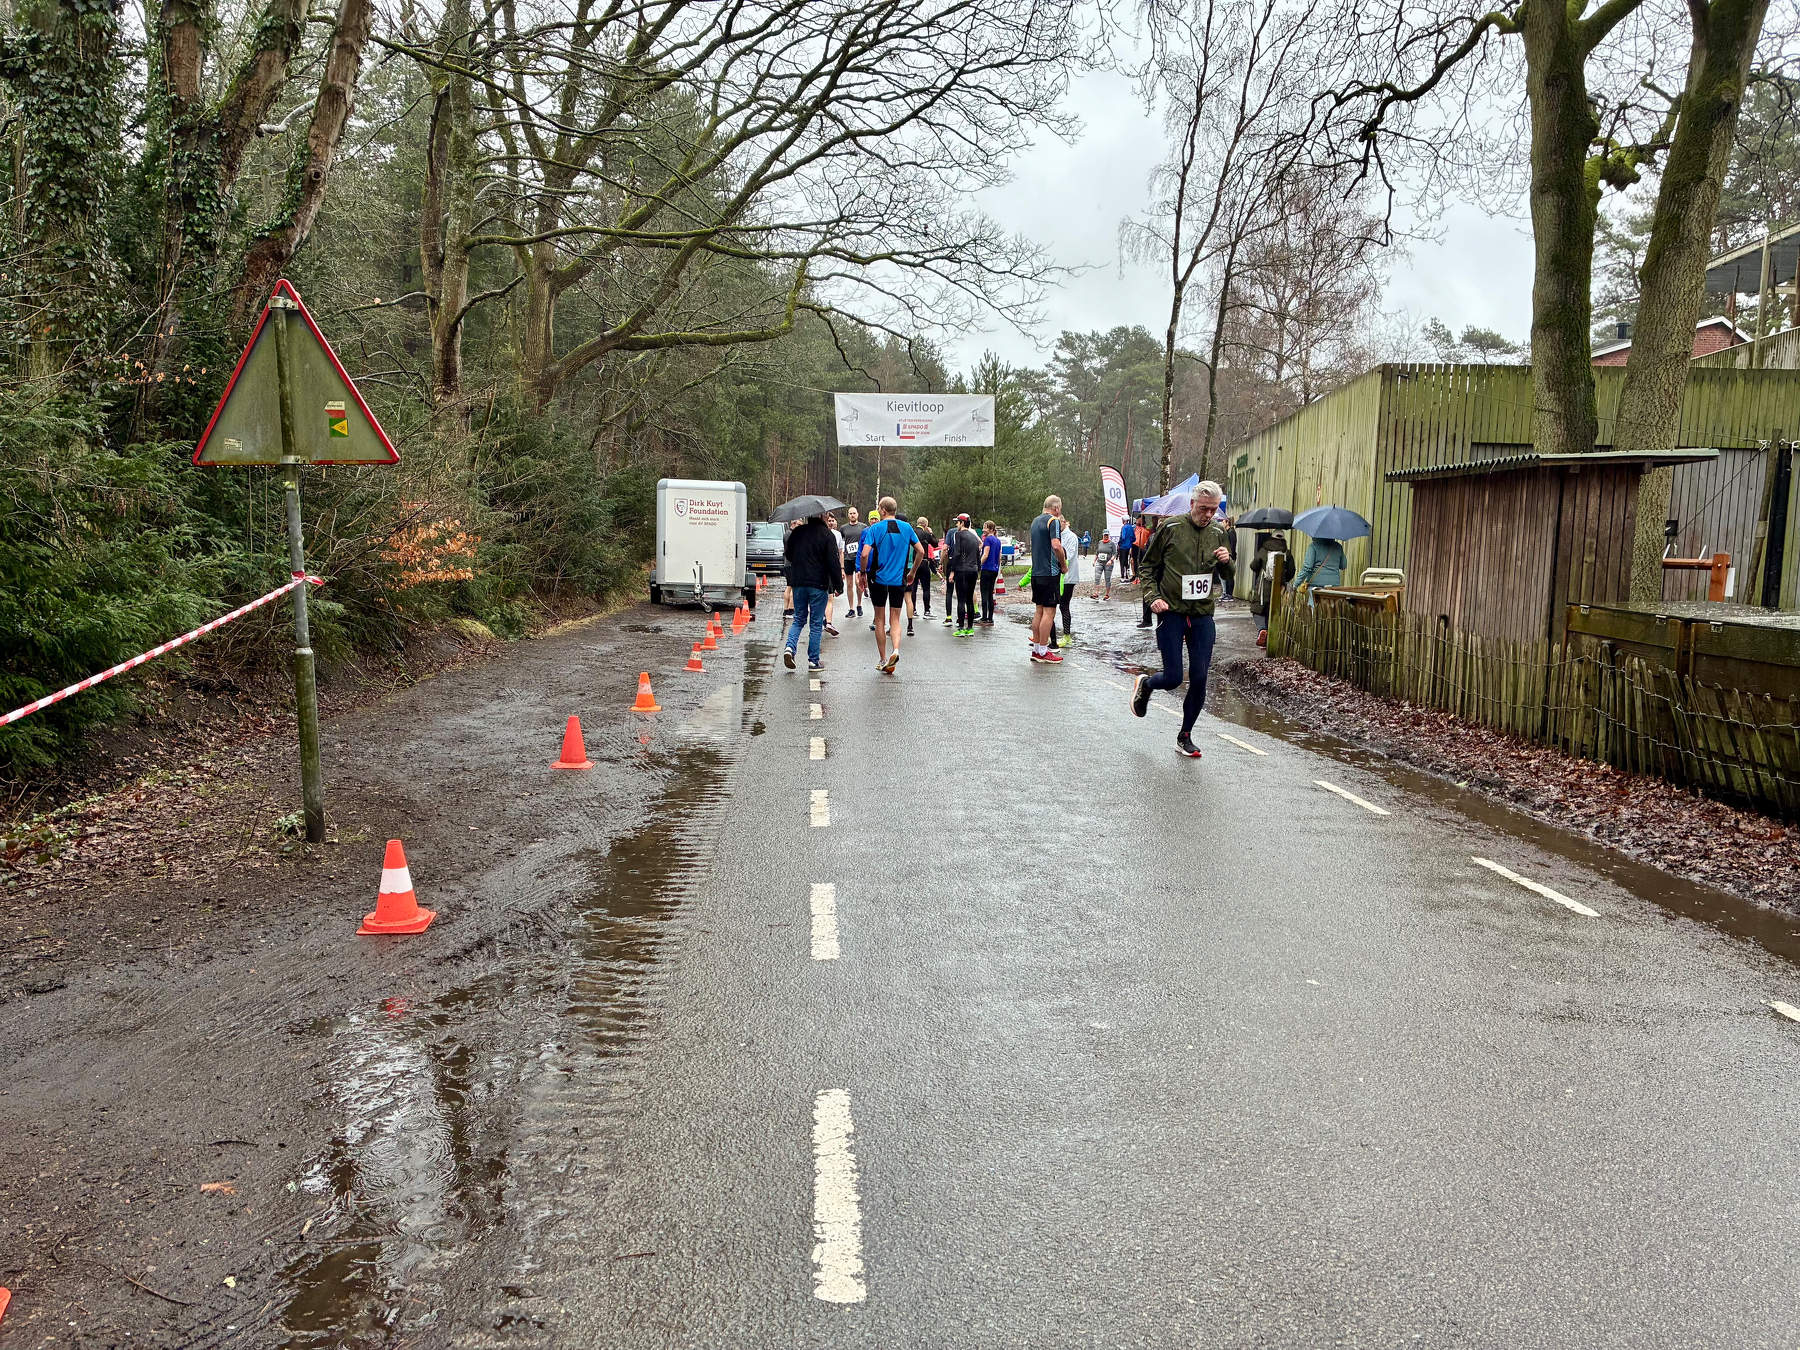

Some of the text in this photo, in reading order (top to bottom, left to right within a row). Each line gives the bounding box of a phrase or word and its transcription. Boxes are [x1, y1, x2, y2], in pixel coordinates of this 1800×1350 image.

[887, 401, 944, 414] Kievitloop
[866, 434, 885, 442] Start
[944, 434, 967, 442] Finish
[706, 500, 723, 508] Kuyt
[1189, 579, 1209, 595] 196
